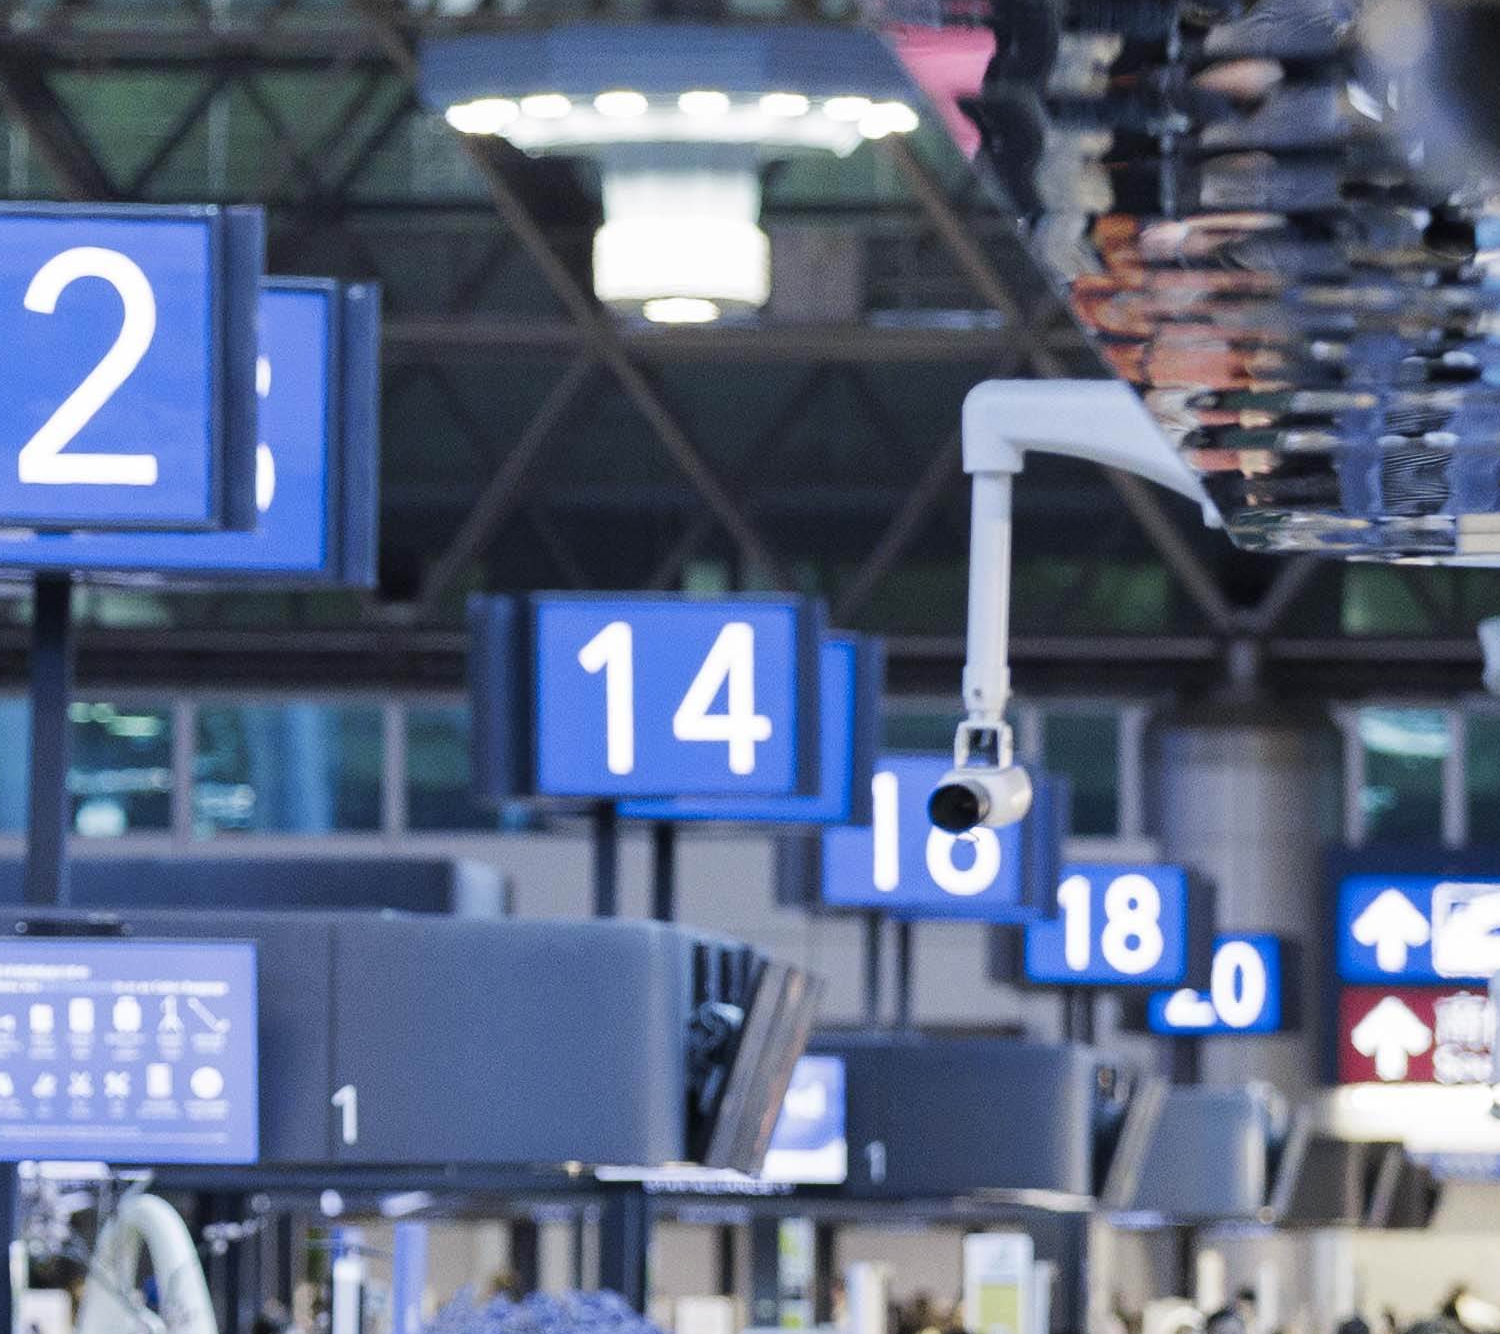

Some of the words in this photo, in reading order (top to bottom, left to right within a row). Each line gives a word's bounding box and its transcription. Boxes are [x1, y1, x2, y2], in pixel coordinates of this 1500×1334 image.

[578, 621, 772, 776] 14
[1057, 874, 1164, 975] 18
[330, 1083, 358, 1147] 1
